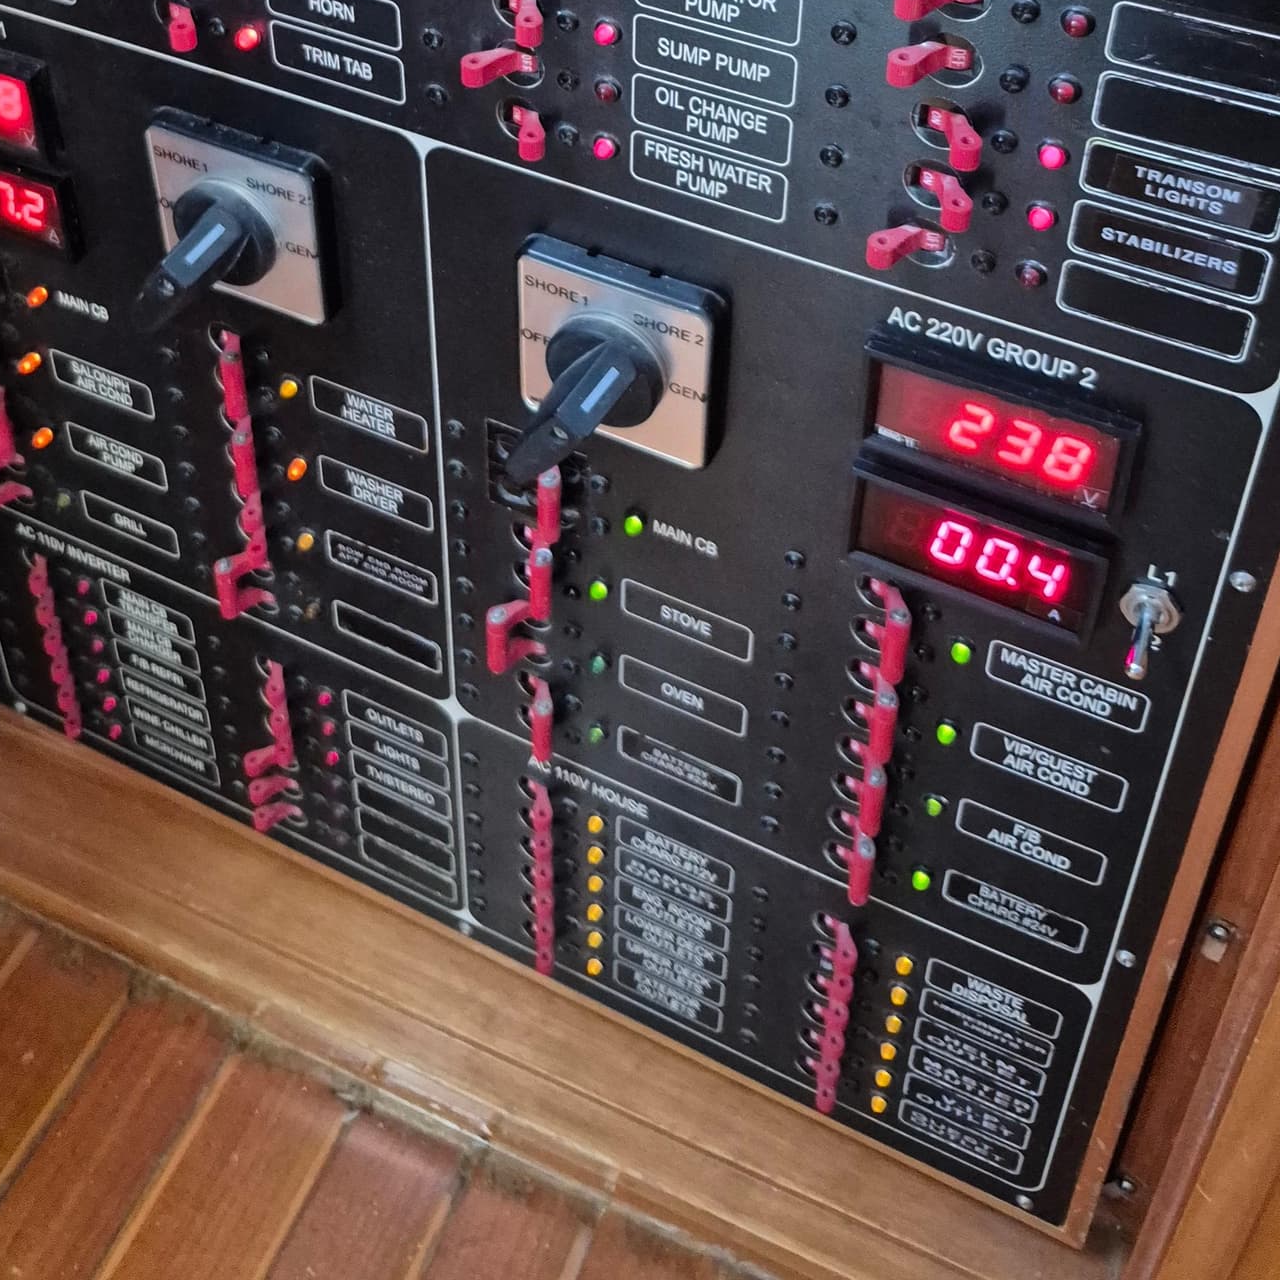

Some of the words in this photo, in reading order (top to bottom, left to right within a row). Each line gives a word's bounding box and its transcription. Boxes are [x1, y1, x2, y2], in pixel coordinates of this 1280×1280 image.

[302, 43, 342, 74] TRIM
[343, 54, 373, 81] TAB
[656, 37, 711, 68] SUMP
[715, 51, 770, 82] PUMP
[655, 86, 686, 112] OIL
[688, 94, 768, 134] CHANGE
[685, 115, 740, 144] PUMP
[644, 139, 704, 171] FRESH
[708, 158, 772, 193] WATER
[675, 169, 728, 200] PUMP
[1134, 164, 1242, 204] TRANSOM
[1144, 183, 1224, 215] LIGHTS
[1100, 226, 1238, 275] STABILIZERS
[57, 289, 91, 316] MAIN
[91, 300, 110, 323] CB
[524, 273, 579, 305] SHORE
[582, 295, 589, 307] 1
[631, 312, 691, 343] SHORE
[694, 333, 705, 347] 2
[887, 306, 922, 333] AC
[925, 318, 985, 352] 220V
[986, 337, 1076, 379] GROUP
[1078, 367, 1098, 390] 2
[70, 359, 130, 393] SALON/PH
[669, 382, 709, 405] GEN
[341, 404, 397, 438] HEATER
[344, 391, 395, 421] WATER
[87, 432, 108, 450] AIR
[108, 440, 143, 466] COND
[948, 402, 1093, 483] 238
[102, 453, 136, 473] PUMP
[346, 468, 404, 503] WASHER
[351, 483, 399, 515] DRYER
[653, 519, 693, 548] MAIN
[694, 532, 719, 559] CB
[929, 519, 1067, 599] 00.4
[660, 604, 713, 639] STOVE
[1000, 646, 1077, 687] MASTER
[1079, 676, 1138, 712] CABIN
[1020, 672, 1055, 700] AIR
[1056, 685, 1112, 718] COND
[661, 681, 705, 713] OVEN
[365, 707, 425, 744] OUTLETS
[373, 740, 420, 770] LIGHTS
[1003, 736, 1098, 784] VIP/GUEST
[554, 765, 590, 791] 110V
[590, 781, 650, 819] HOUSE
[1002, 752, 1036, 779] AIR
[1037, 765, 1091, 798] COND
[987, 827, 1019, 853] AIR
[1020, 838, 1072, 871] COND
[1012, 822, 1043, 845] F/B
[967, 892, 1020, 923] CHARG
[978, 883, 1048, 922] BATTERY
[951, 981, 1032, 1026] DISPOSAL
[967, 975, 1026, 1010] WASTE
